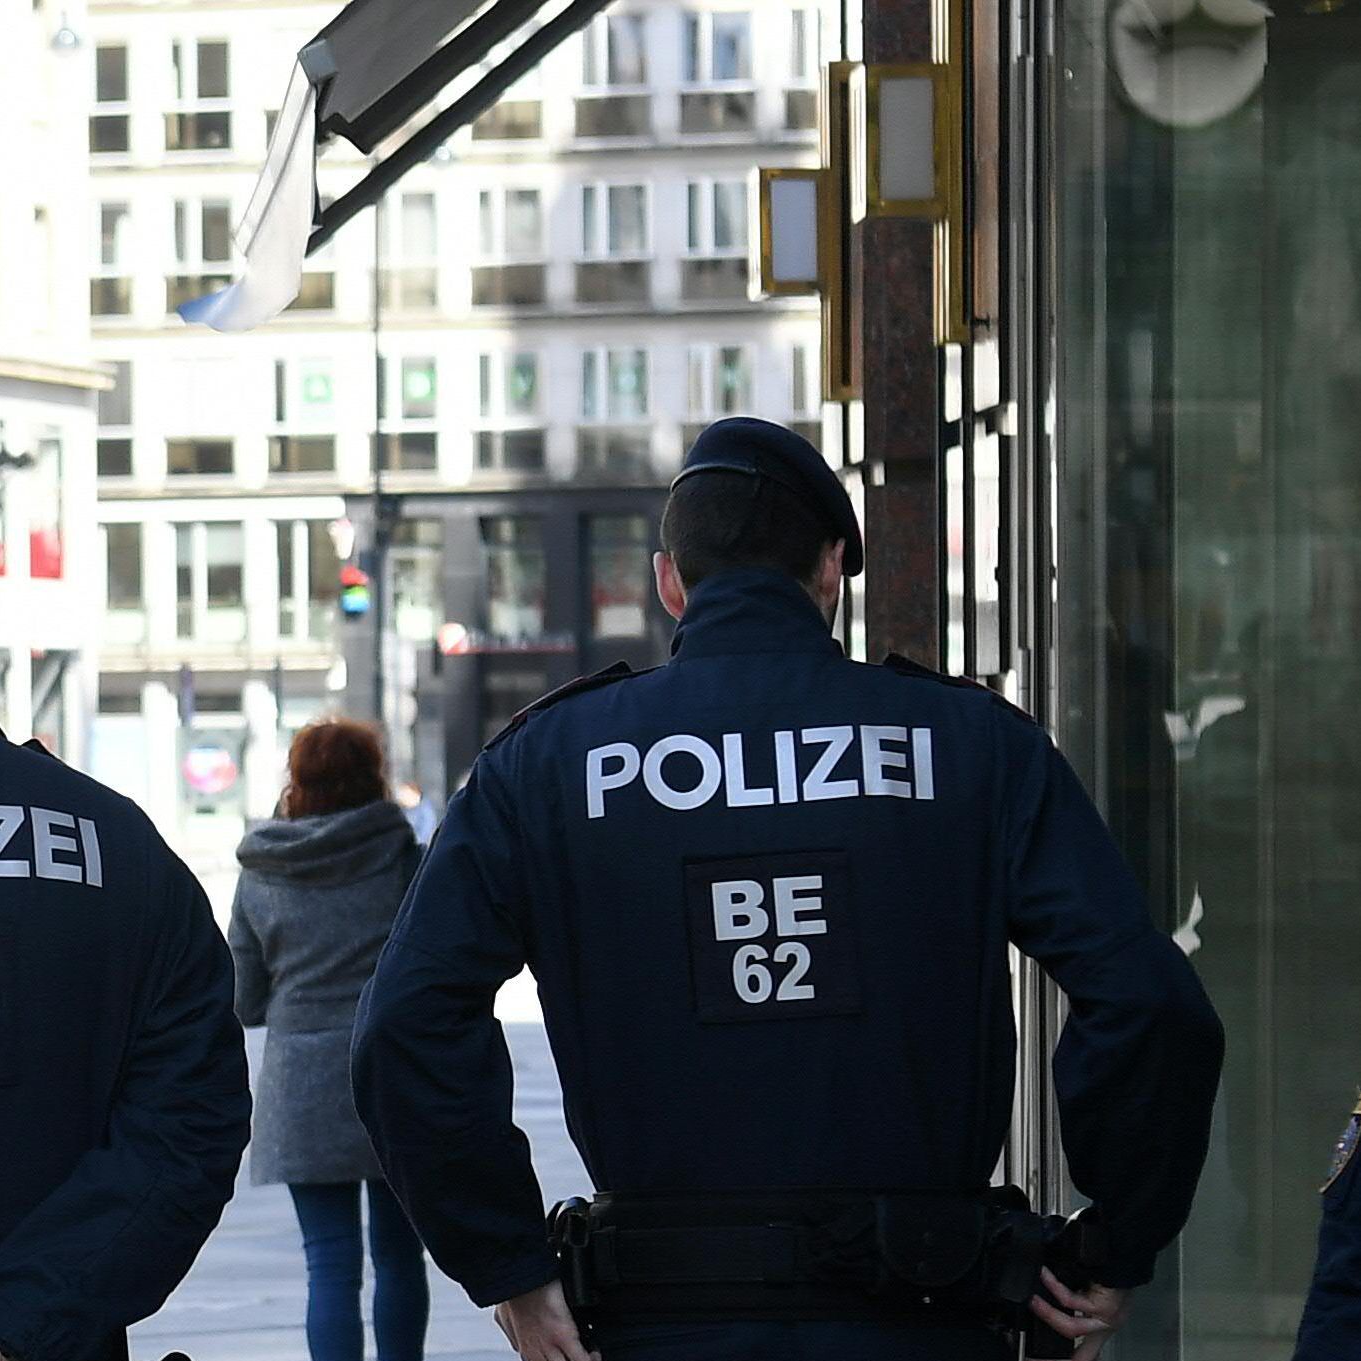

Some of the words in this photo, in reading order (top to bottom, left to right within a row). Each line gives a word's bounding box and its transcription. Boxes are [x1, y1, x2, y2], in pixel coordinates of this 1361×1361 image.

[585, 724, 935, 820] POLIZEI
[710, 874, 828, 942] BE
[731, 940, 816, 1005] 62
